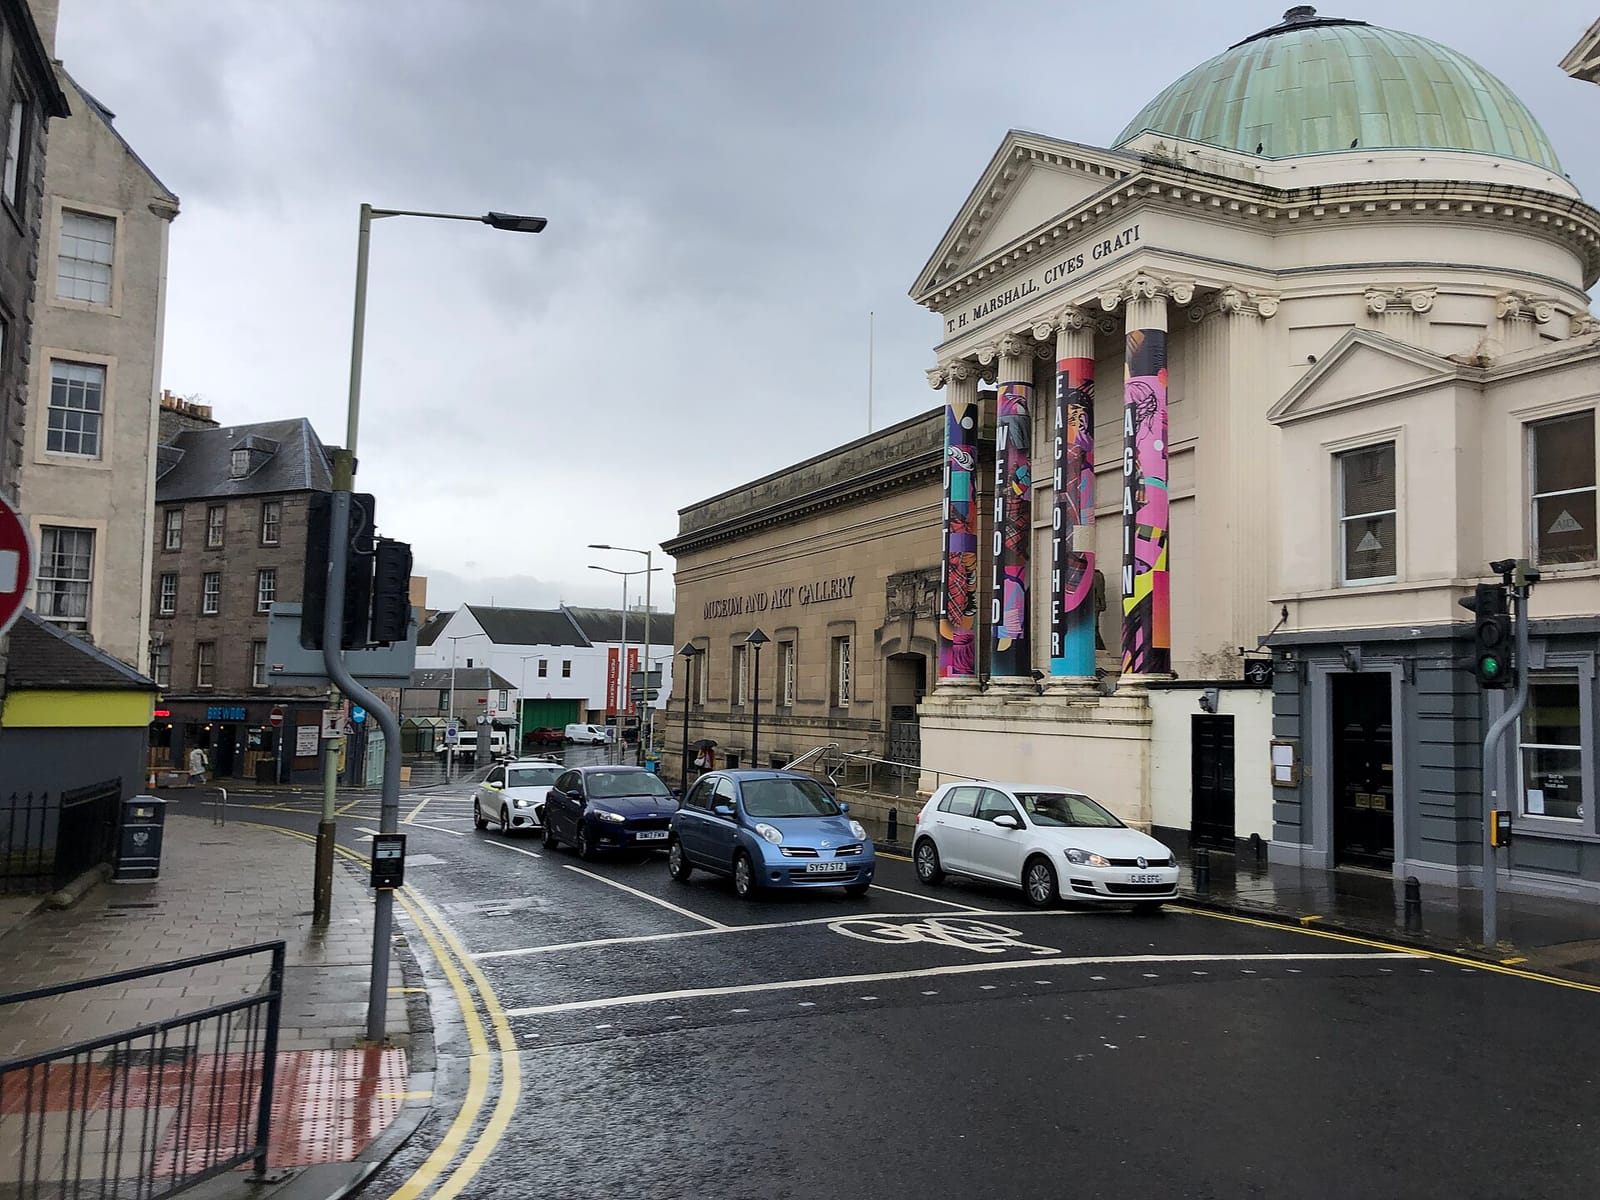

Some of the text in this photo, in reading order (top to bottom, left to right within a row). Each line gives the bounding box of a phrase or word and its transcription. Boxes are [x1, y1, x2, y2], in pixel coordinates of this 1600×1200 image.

[946, 224, 1141, 333] T. H. MARSHALL, CIVES GRATI
[940, 466, 950, 615] UNTIL
[991, 425, 1009, 624] WE HOLD
[1051, 375, 1064, 656] EACH OTHER
[1122, 408, 1134, 595] AGAIN
[703, 575, 855, 620] MUSEUM AND ART GALLERY
[207, 707, 246, 720] BREWDOG
[809, 862, 844, 871] SY57 STZ
